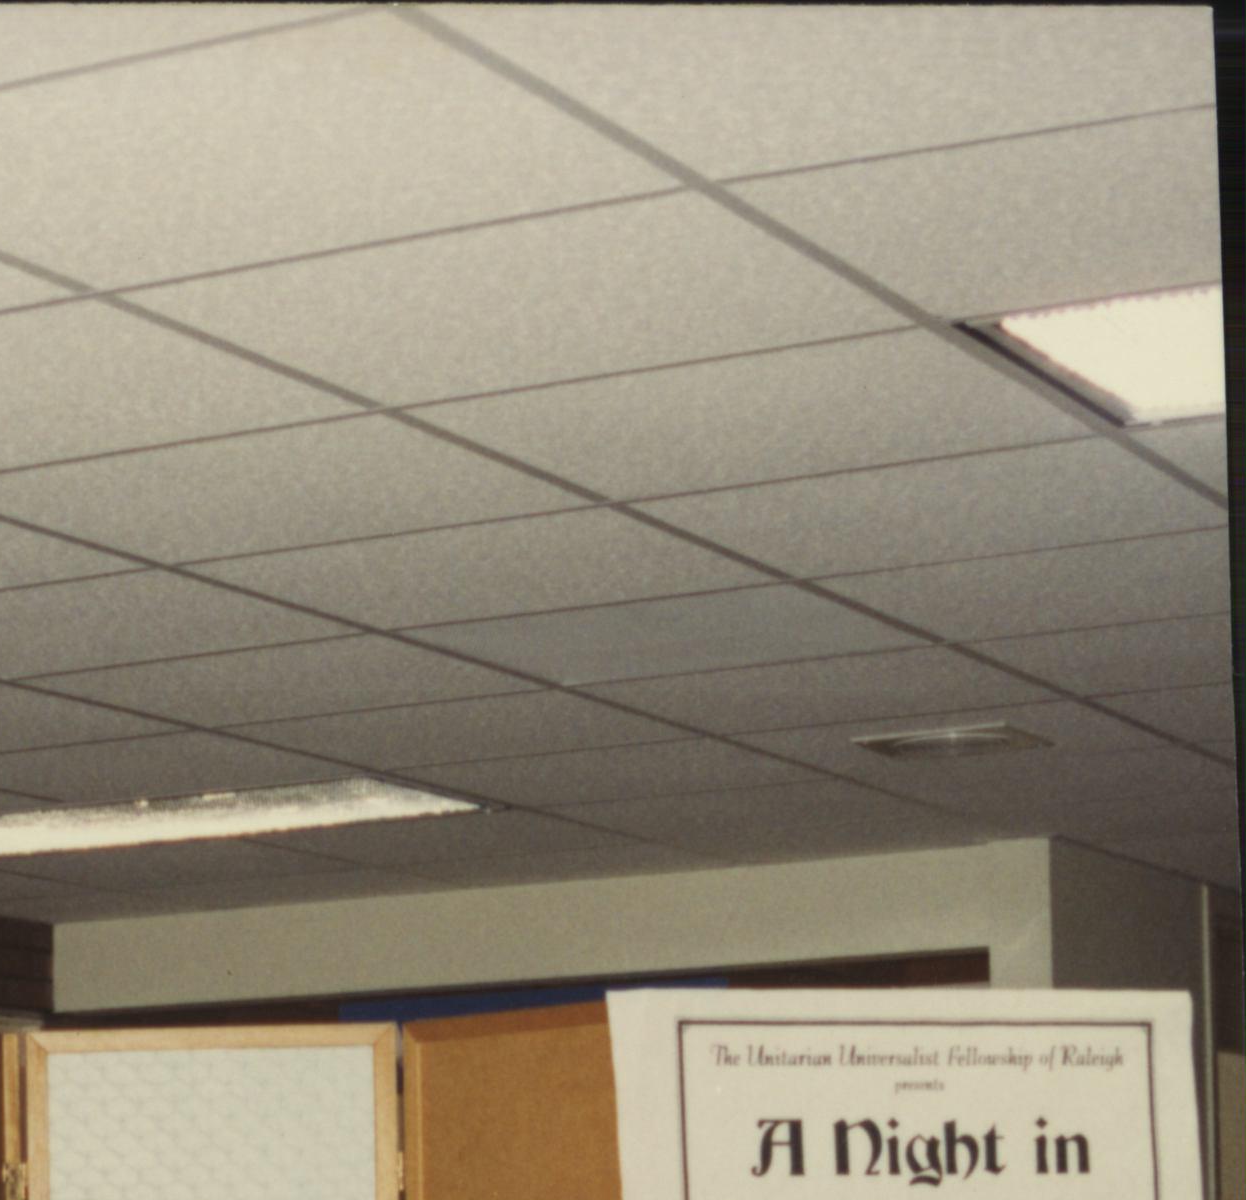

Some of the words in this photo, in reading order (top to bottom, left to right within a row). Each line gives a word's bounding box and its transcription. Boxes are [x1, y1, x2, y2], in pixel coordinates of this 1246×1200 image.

[710, 1043, 741, 1067] The
[746, 1043, 832, 1067] Unitarian
[839, 1043, 940, 1067] Universalist
[946, 1044, 1033, 1073] Fellowship
[1039, 1043, 1056, 1072] of
[1061, 1043, 1125, 1072] Raleigh
[894, 1079, 946, 1095] presents
[751, 1117, 805, 1178] A
[832, 1116, 1007, 1188] Night
[1034, 1116, 1091, 1176] in
